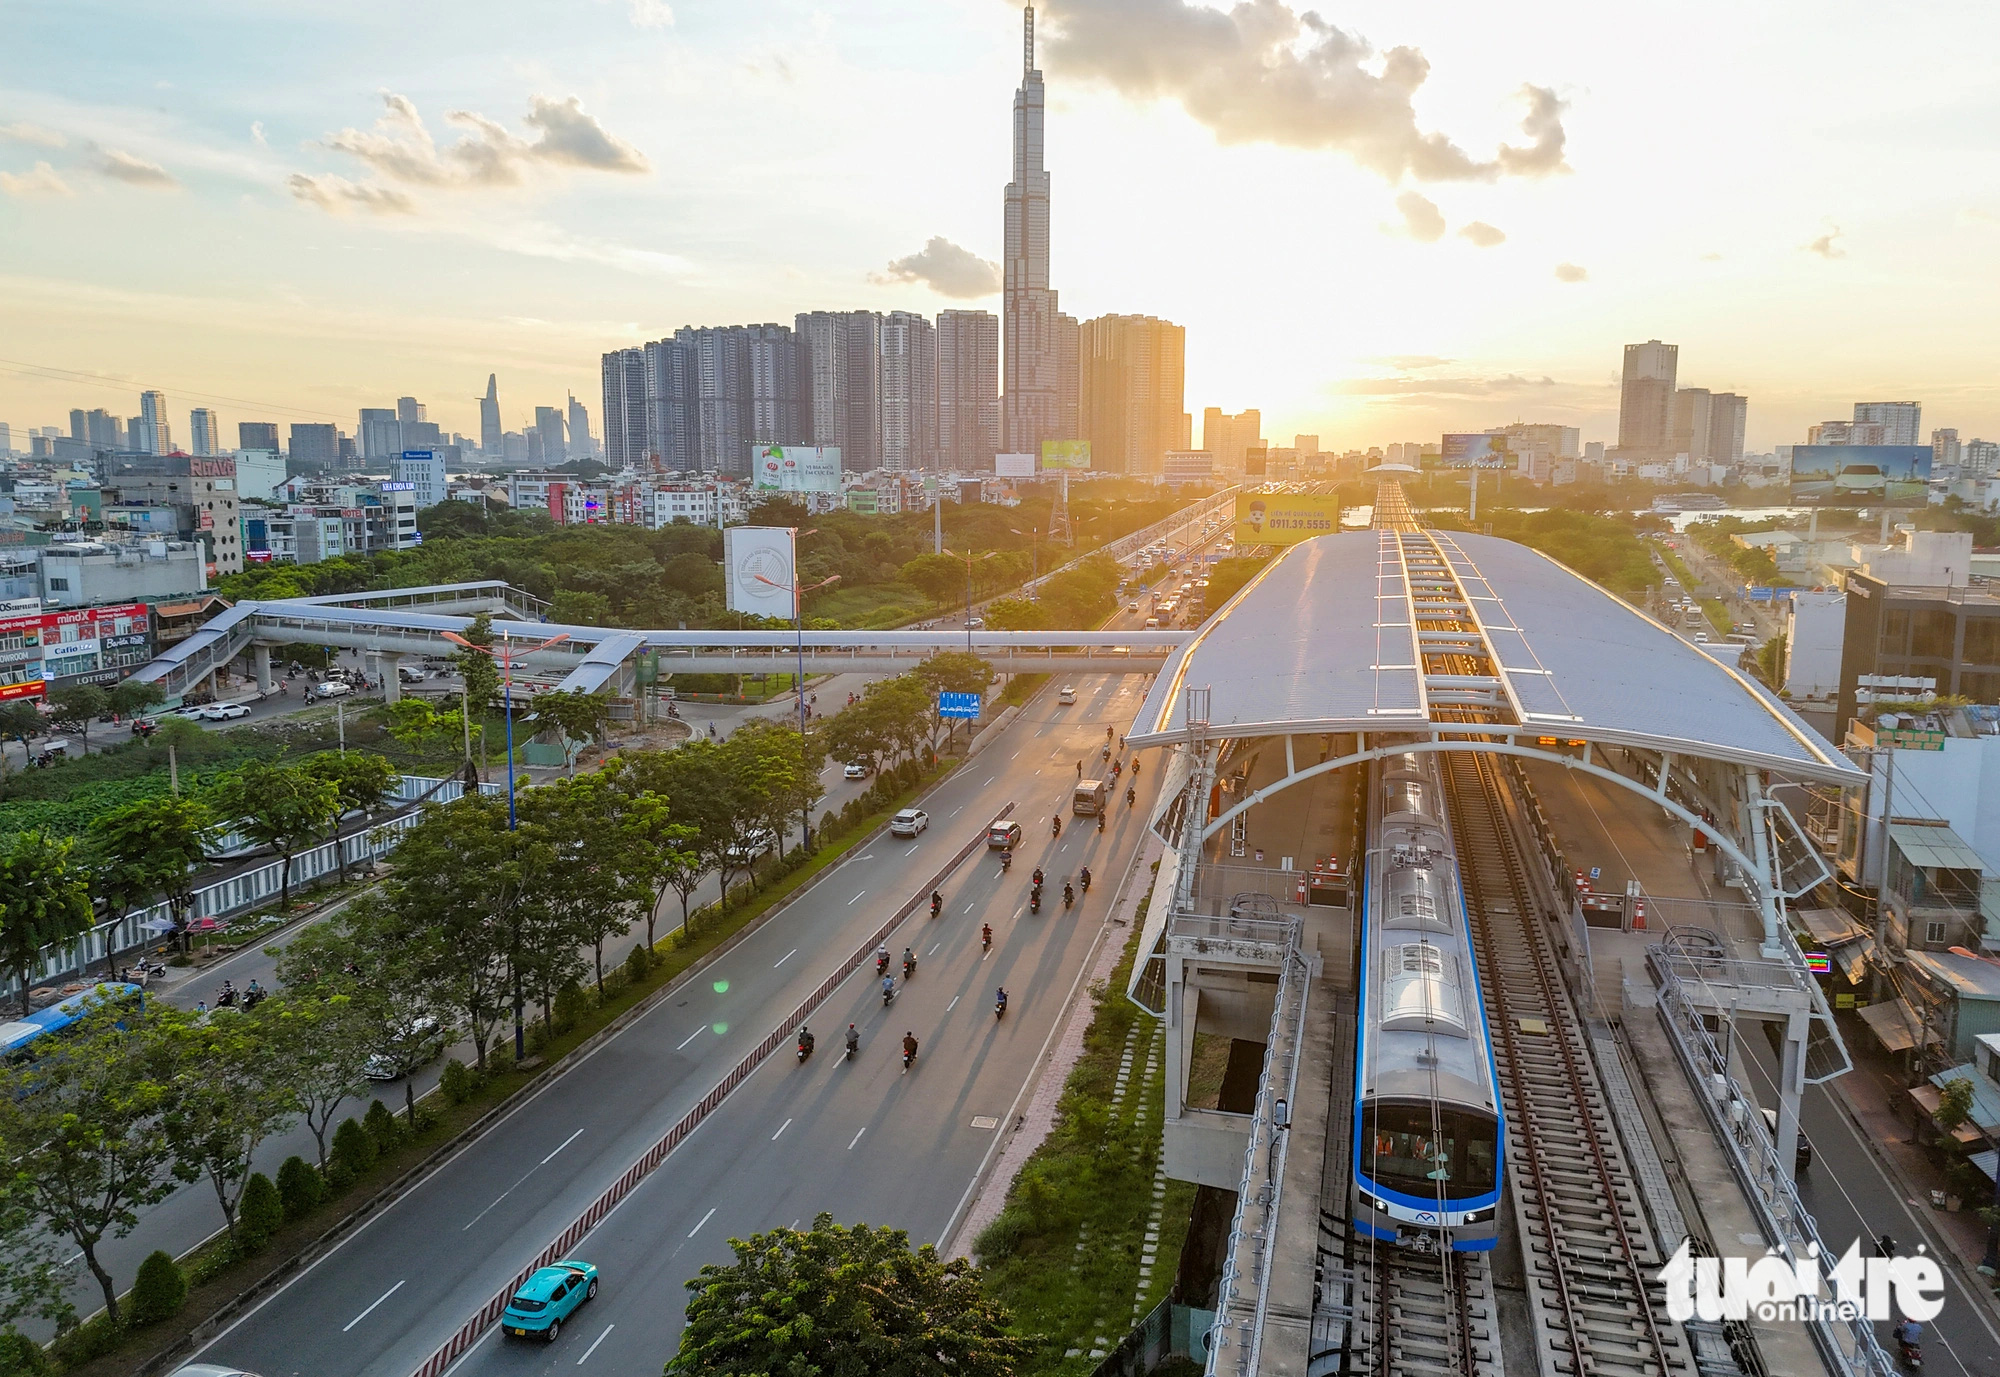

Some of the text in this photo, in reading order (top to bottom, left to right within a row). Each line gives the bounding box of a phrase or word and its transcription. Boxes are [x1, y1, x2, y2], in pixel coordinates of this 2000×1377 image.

[341, 508, 364, 518] HOTEL
[1269, 519, 1331, 530] 0911.39.5555
[57, 611, 90, 624] mindX
[76, 672, 119, 685] LOTTERIA
